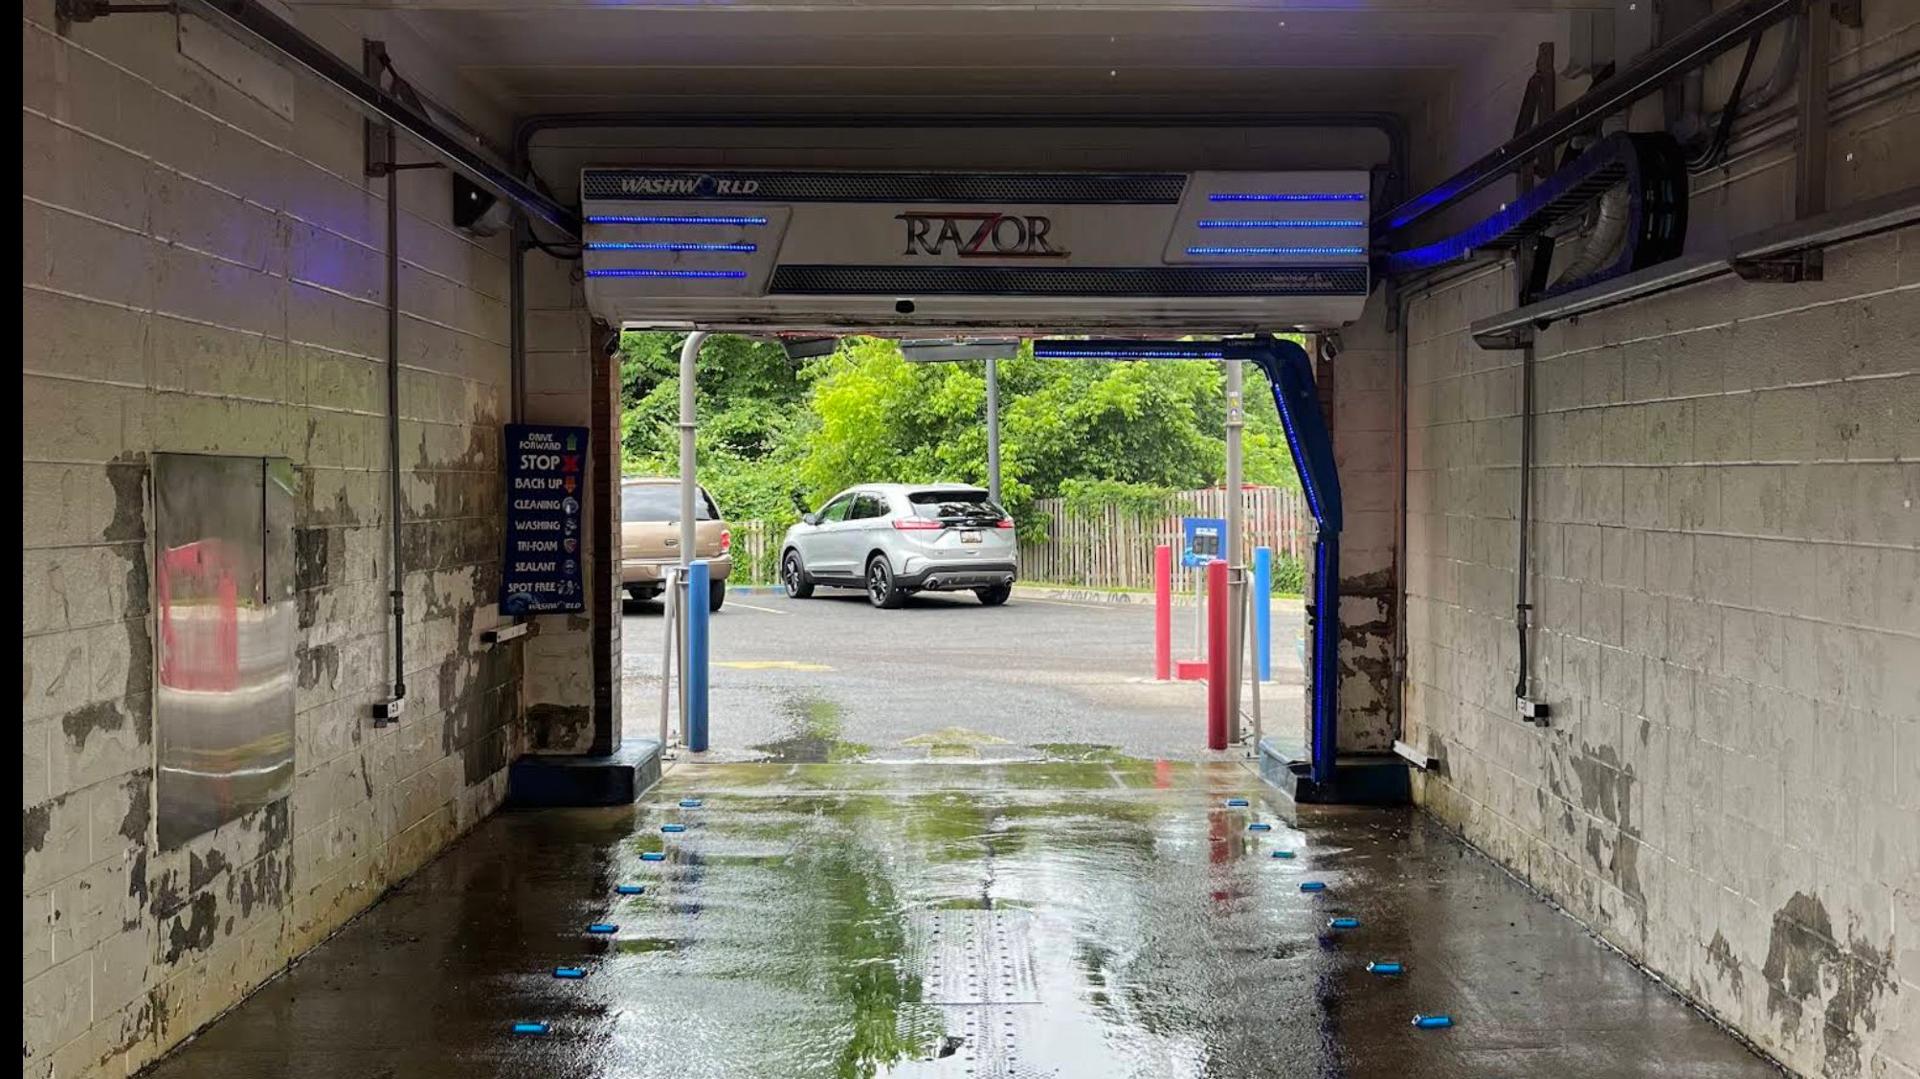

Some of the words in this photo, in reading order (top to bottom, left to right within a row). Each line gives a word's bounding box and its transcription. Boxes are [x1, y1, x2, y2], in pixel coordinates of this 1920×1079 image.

[894, 211, 1072, 258] RAZOR
[528, 433, 553, 442] DRIVE
[519, 441, 562, 451] FORWARD
[520, 454, 561, 470] STOP
[515, 478, 545, 489] BACK
[548, 478, 563, 489] UP
[514, 500, 561, 510] CLEANING
[515, 520, 561, 531] WASHING
[518, 541, 558, 552] TRI-FOAM
[515, 562, 556, 572] SEALANT
[507, 582, 533, 593] SPOT
[534, 582, 556, 592] FREE
